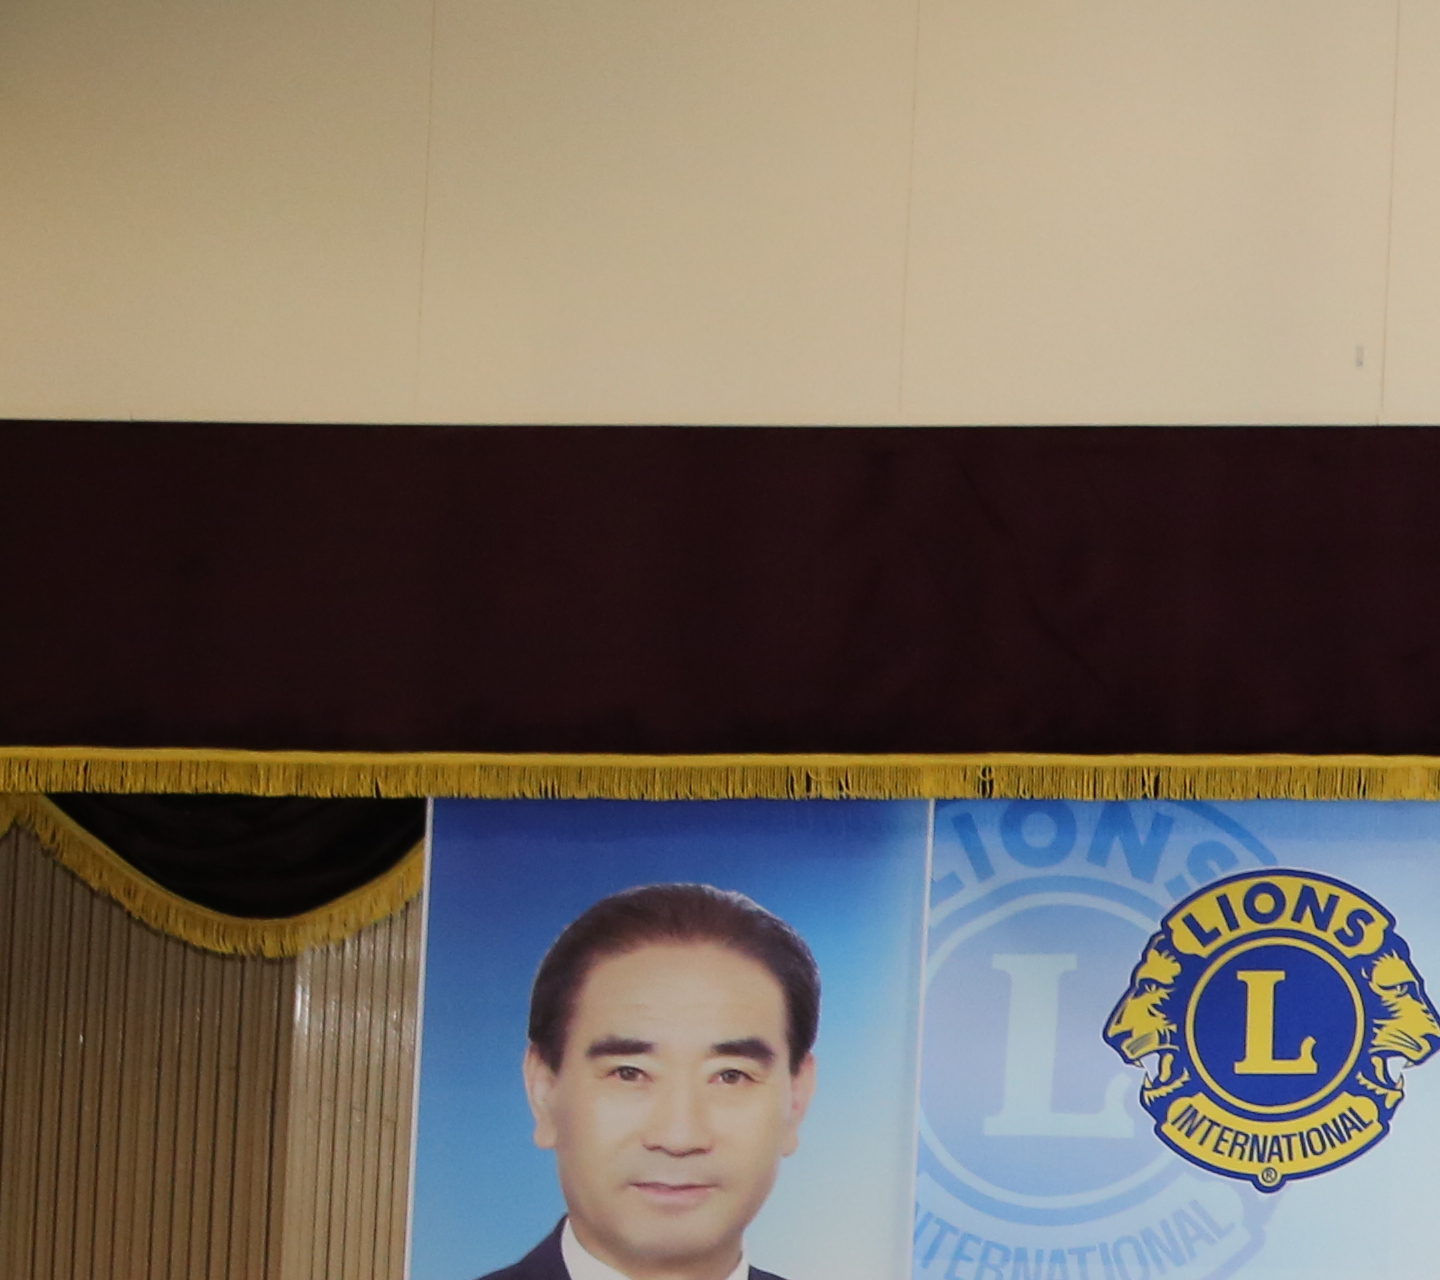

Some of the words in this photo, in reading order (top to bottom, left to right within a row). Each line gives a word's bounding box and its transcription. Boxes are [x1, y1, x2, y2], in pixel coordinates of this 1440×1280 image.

[1181, 882, 1374, 949] LIONS
[1234, 969, 1318, 1075] L
[1173, 1103, 1376, 1164] INTERNATIONAL
